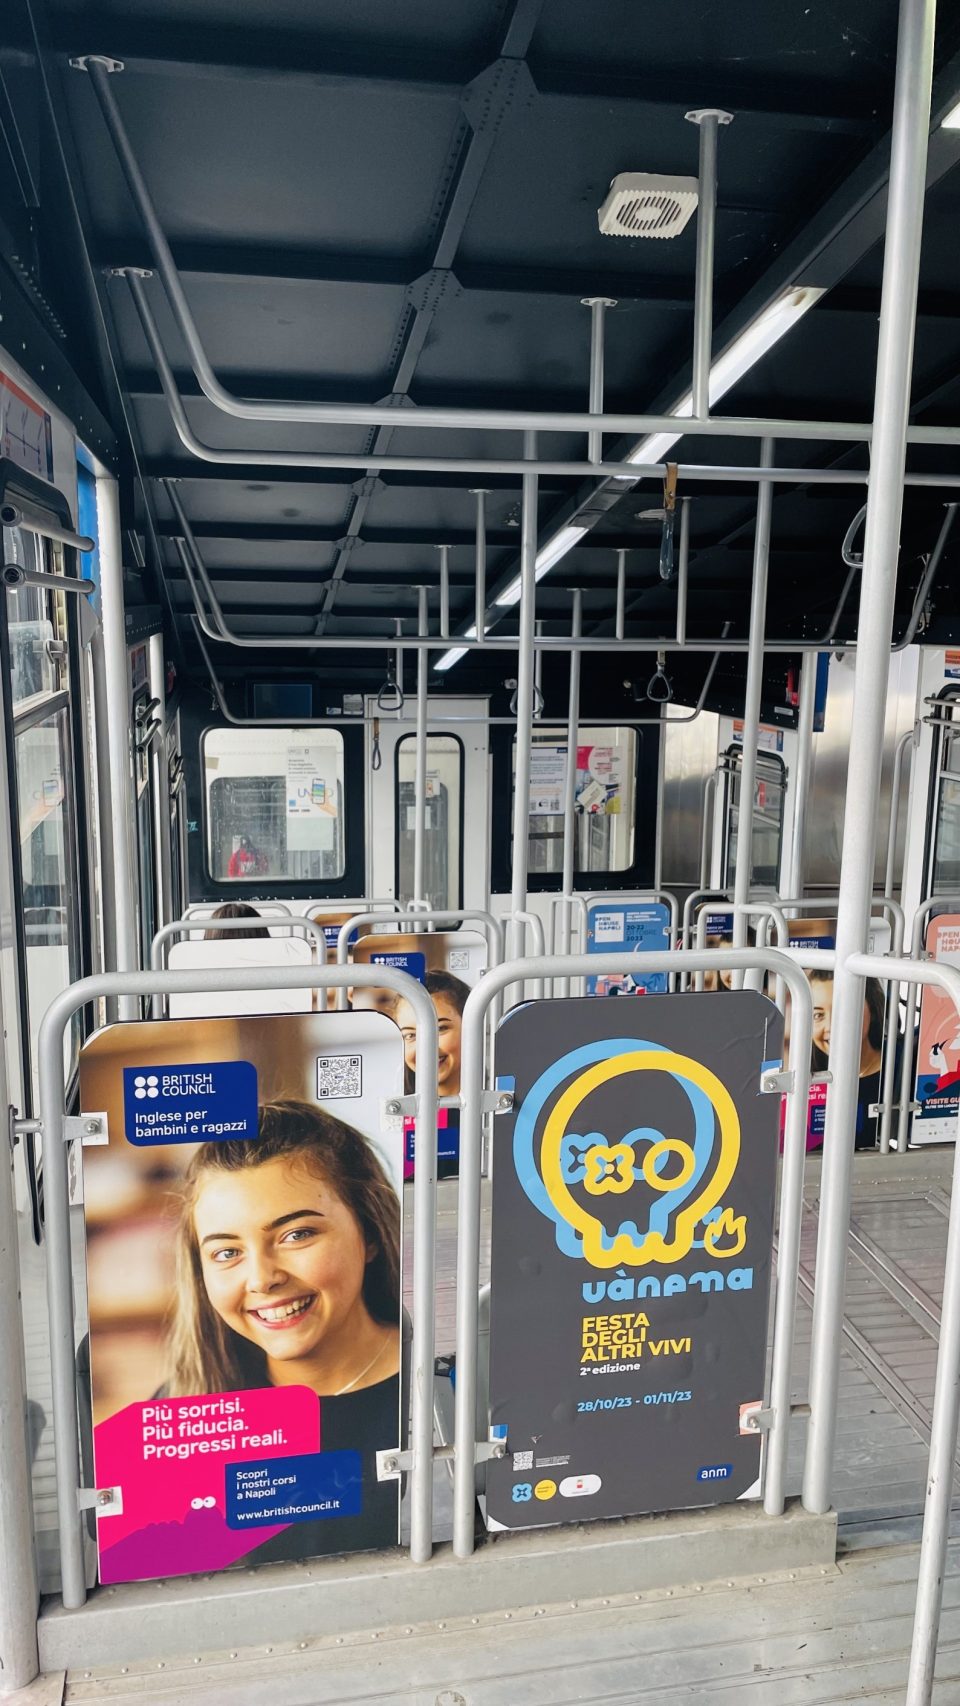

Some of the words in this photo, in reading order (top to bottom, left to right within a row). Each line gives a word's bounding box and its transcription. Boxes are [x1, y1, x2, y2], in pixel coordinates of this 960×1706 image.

[162, 1073, 213, 1086] BRITISH
[161, 1084, 217, 1097] COUNCIL
[926, 1097, 949, 1105] VISITE
[135, 1111, 182, 1126] Inglese
[185, 1110, 208, 1122] per
[135, 1123, 187, 1138] bambini
[190, 1125, 199, 1134] e
[202, 1119, 247, 1135] ragazzi
[582, 1312, 651, 1333] FESTA
[581, 1327, 647, 1348] DEGLI
[580, 1342, 643, 1363] ALTRI
[647, 1337, 692, 1356] VIVI
[592, 1362, 641, 1375] edizione
[577, 1397, 633, 1412] 28/10/23
[643, 1390, 692, 1405] 01/11/23
[142, 1404, 173, 1423] Più
[178, 1397, 245, 1419] sorrisi.
[142, 1423, 173, 1442] Più
[178, 1416, 249, 1438] fiducia.
[143, 1434, 236, 1460] Progressi
[241, 1428, 288, 1449] reali.
[236, 1468, 268, 1480] Scopri
[701, 1467, 727, 1479] anm
[236, 1481, 240, 1490] i
[241, 1478, 270, 1489] nostri
[272, 1475, 297, 1486] corsi
[236, 1492, 243, 1500] a
[245, 1487, 276, 1499] Napoli
[236, 1500, 340, 1521] www.britishcouncil.it
